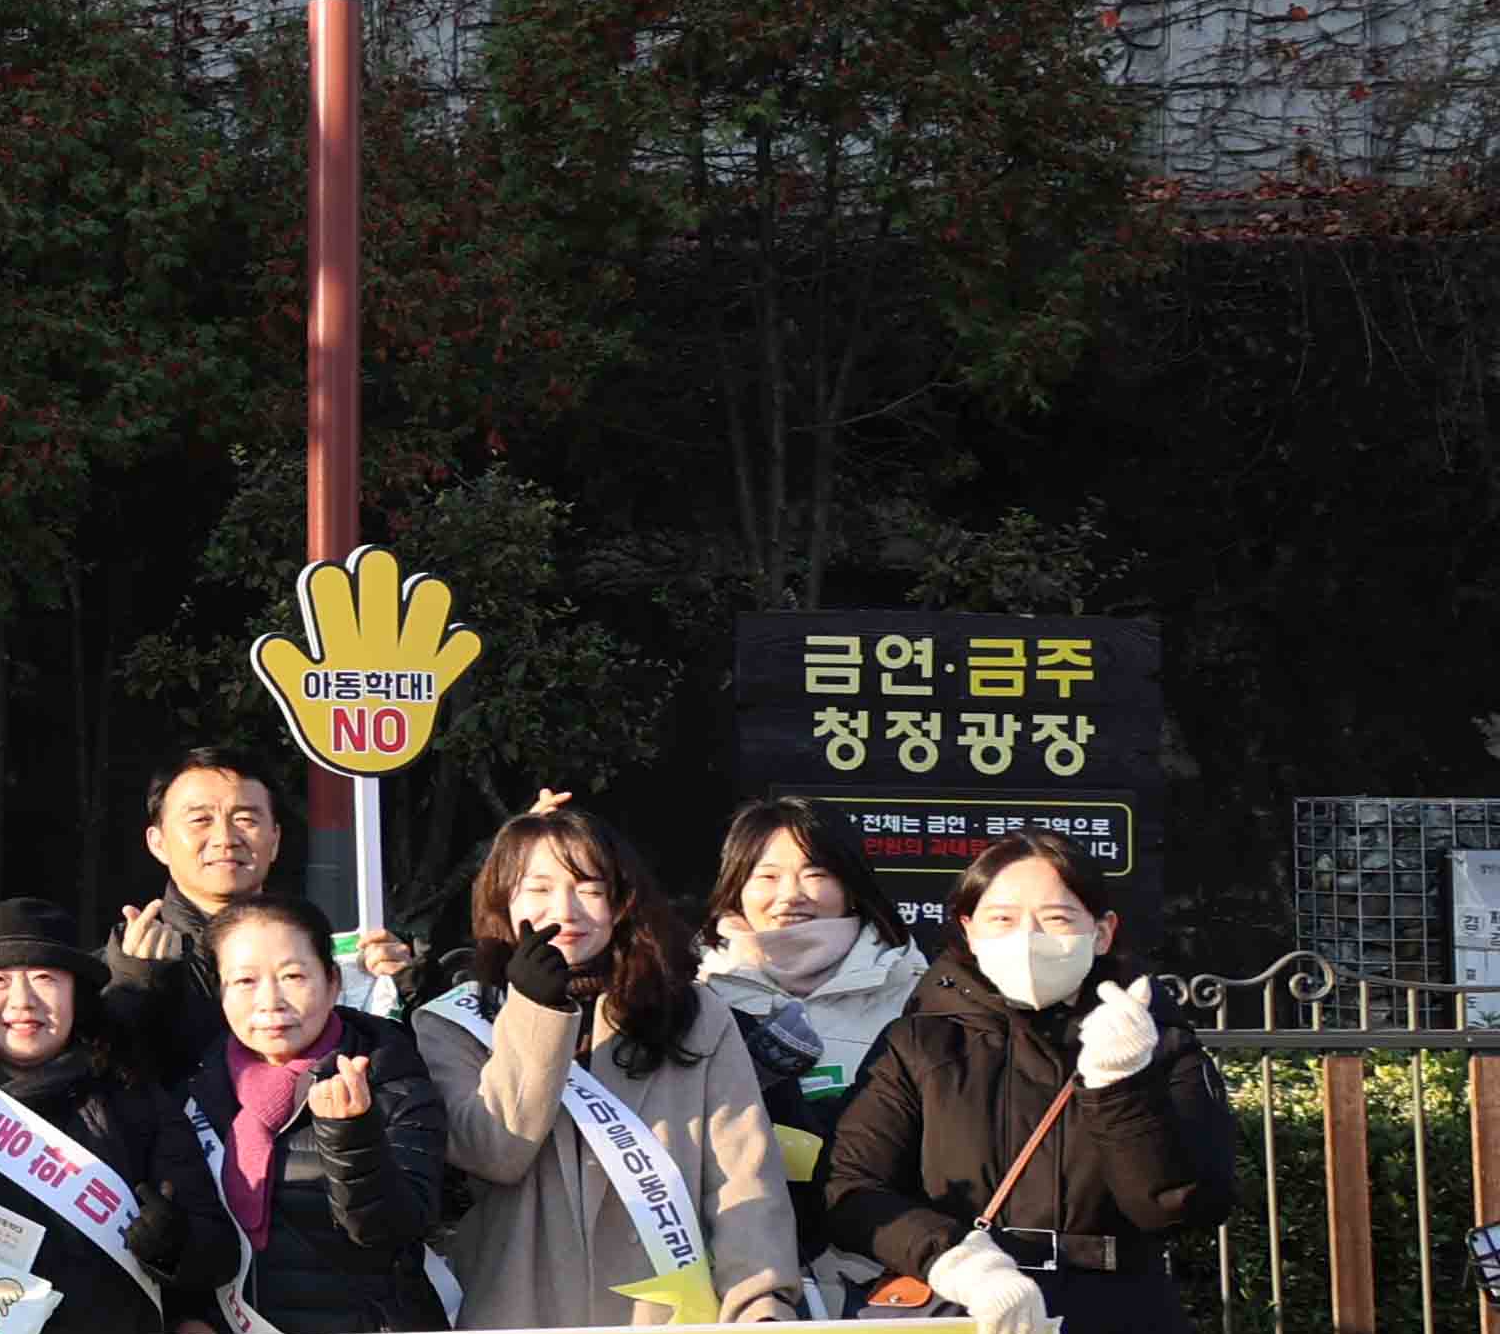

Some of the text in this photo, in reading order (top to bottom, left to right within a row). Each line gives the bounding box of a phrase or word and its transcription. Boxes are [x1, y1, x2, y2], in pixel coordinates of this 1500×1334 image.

[303, 671, 433, 701] 아동학대!
[332, 707, 407, 752] NO
[861, 814, 921, 834] 전체는
[926, 815, 966, 834] 금연
